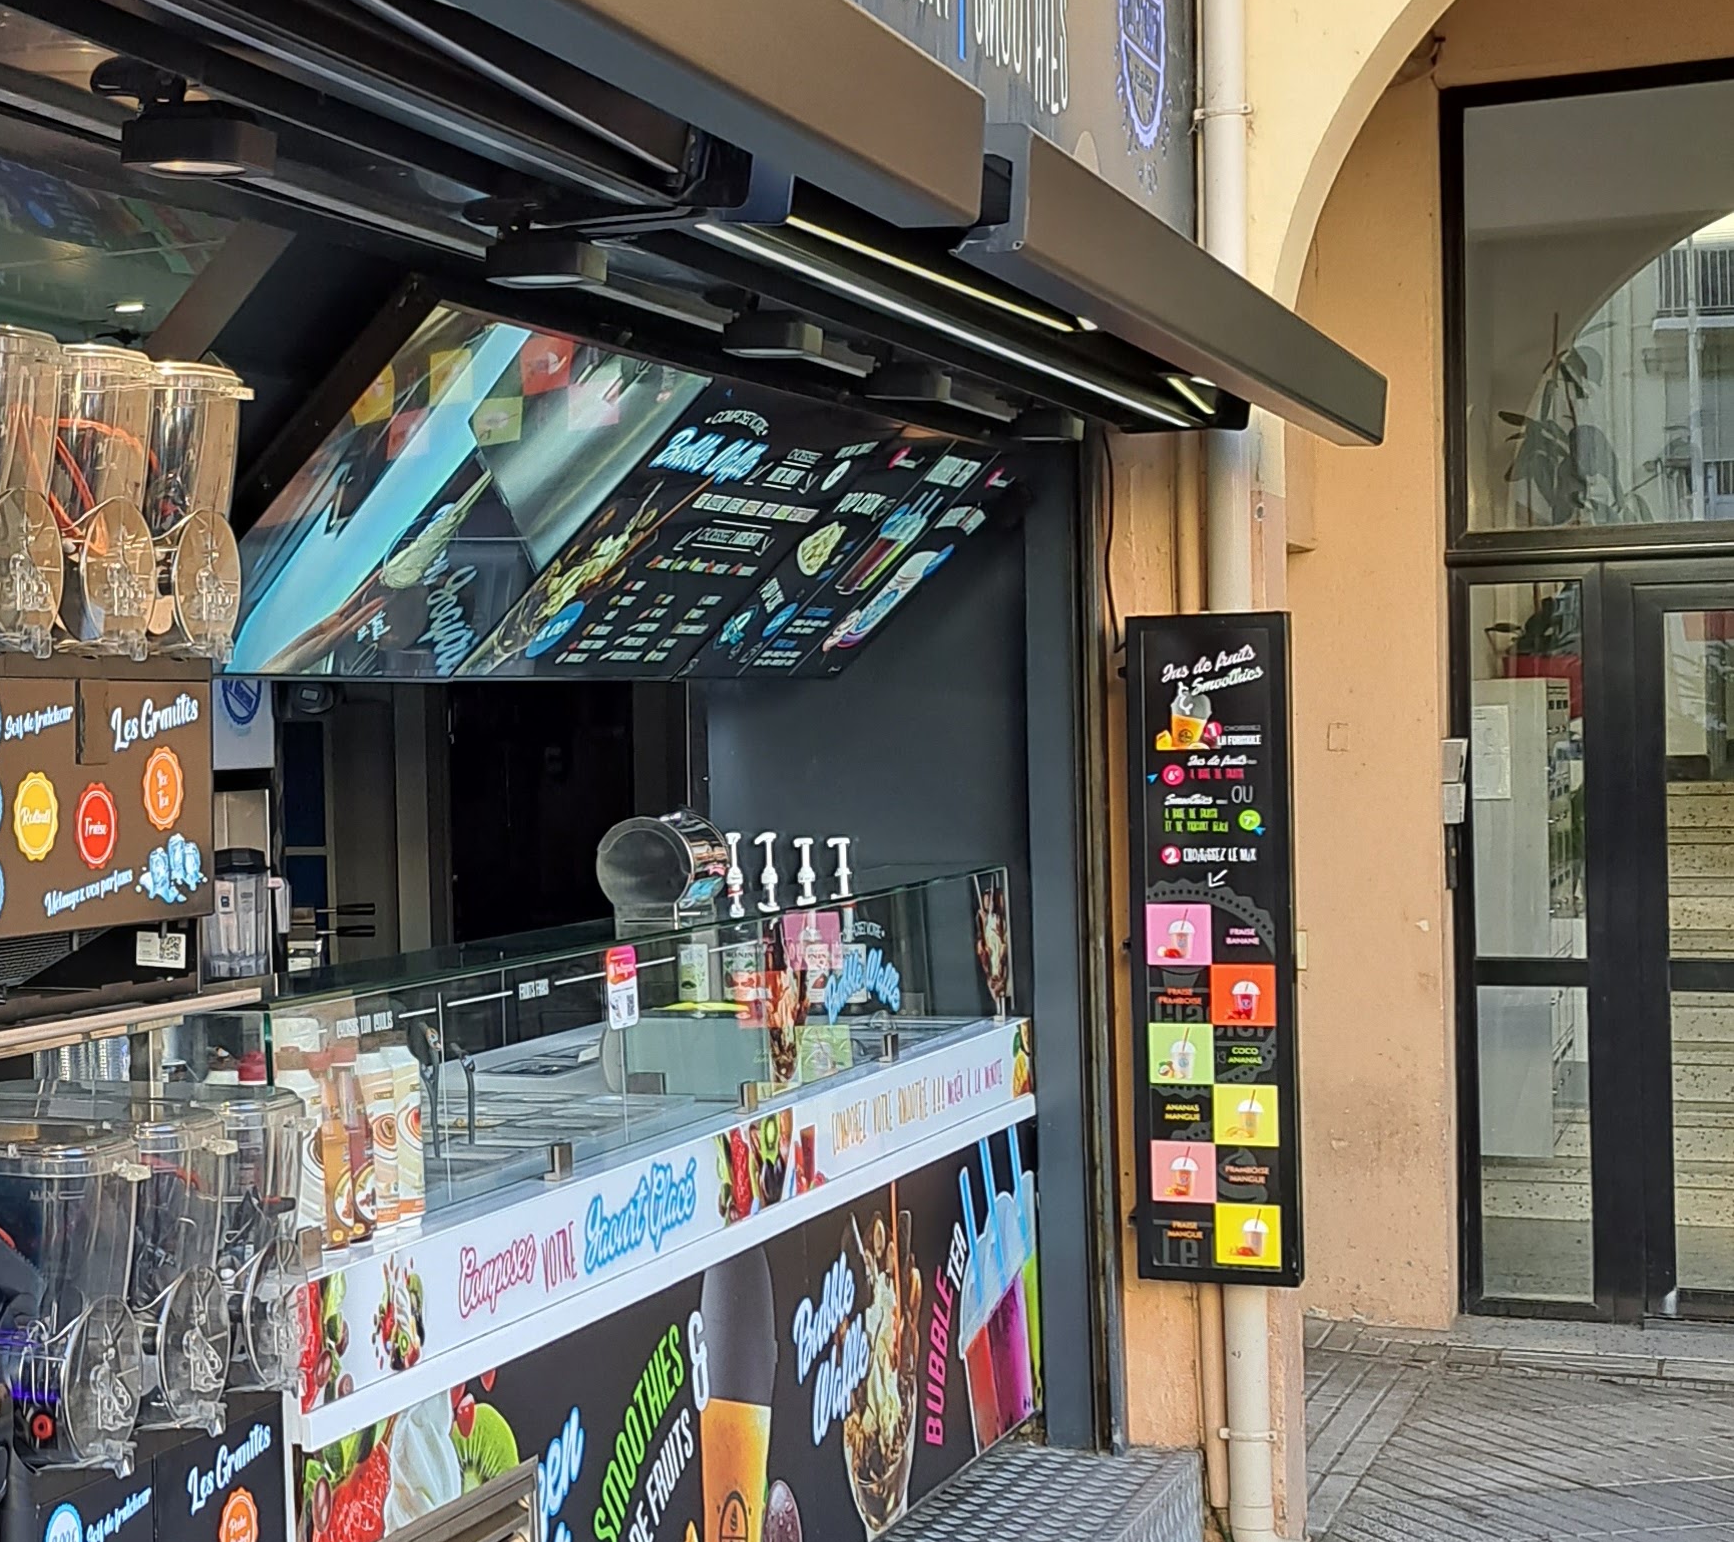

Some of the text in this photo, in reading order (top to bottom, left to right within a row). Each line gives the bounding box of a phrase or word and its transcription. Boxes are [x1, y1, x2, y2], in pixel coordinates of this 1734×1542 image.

[1161, 644, 1257, 684] Jus de fruits
[1191, 665, 1265, 697] Smoothies
[110, 706, 139, 753] Les
[1231, 784, 1254, 804] OU
[84, 816, 109, 838] Fraise
[1164, 845, 1181, 865] 2
[1227, 846, 1239, 862] LE
[100, 868, 134, 900] parfums
[1225, 935, 1261, 947] BANANE
[1228, 926, 1257, 938] FRAISE
[1226, 1054, 1264, 1066] ANANAS
[1231, 1046, 1260, 1057] COCO
[1164, 1111, 1202, 1123] MANGUE
[1165, 1102, 1201, 1114] ANANAS
[1224, 1164, 1270, 1177] FRAMBOISE
[1228, 1174, 1267, 1186] MANGUE
[1166, 1228, 1204, 1240] MANGUE
[1171, 1220, 1199, 1231] FRAISE
[458, 1233, 537, 1320] Composez
[541, 1219, 578, 1294] VOTRE
[648, 1156, 698, 1253] Glacé
[947, 1221, 968, 1292] TEA
[792, 1250, 855, 1386] Bubble
[925, 1264, 954, 1447] BUBBLE
[813, 1308, 869, 1447] Waffle
[645, 1407, 695, 1528] FRUITS
[186, 1466, 215, 1517] Les
